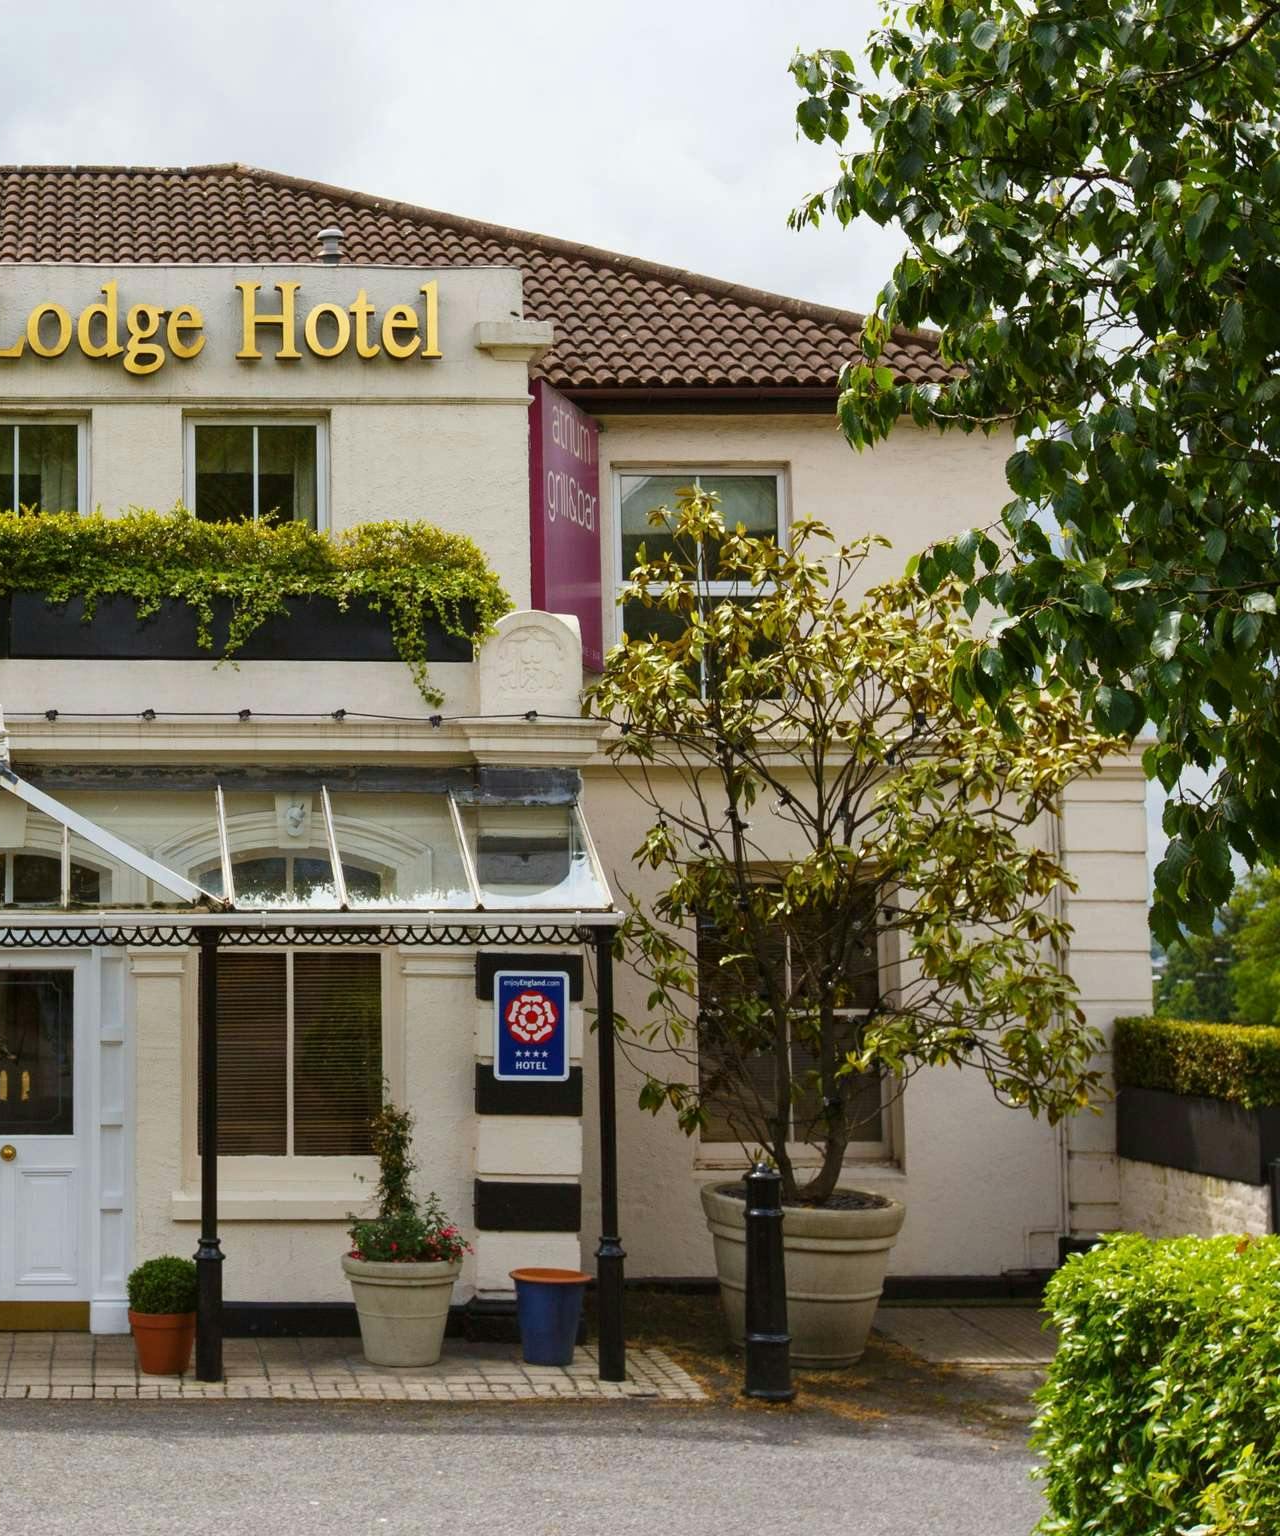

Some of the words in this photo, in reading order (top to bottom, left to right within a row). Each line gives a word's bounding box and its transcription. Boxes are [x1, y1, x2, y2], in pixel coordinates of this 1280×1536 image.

[235, 279, 443, 361] Hotel
[552, 404, 591, 465] atrium
[547, 470, 597, 533] grill&bar
[504, 979, 561, 988] enjoyEngland.com
[515, 1061, 548, 1070] HOTEL
